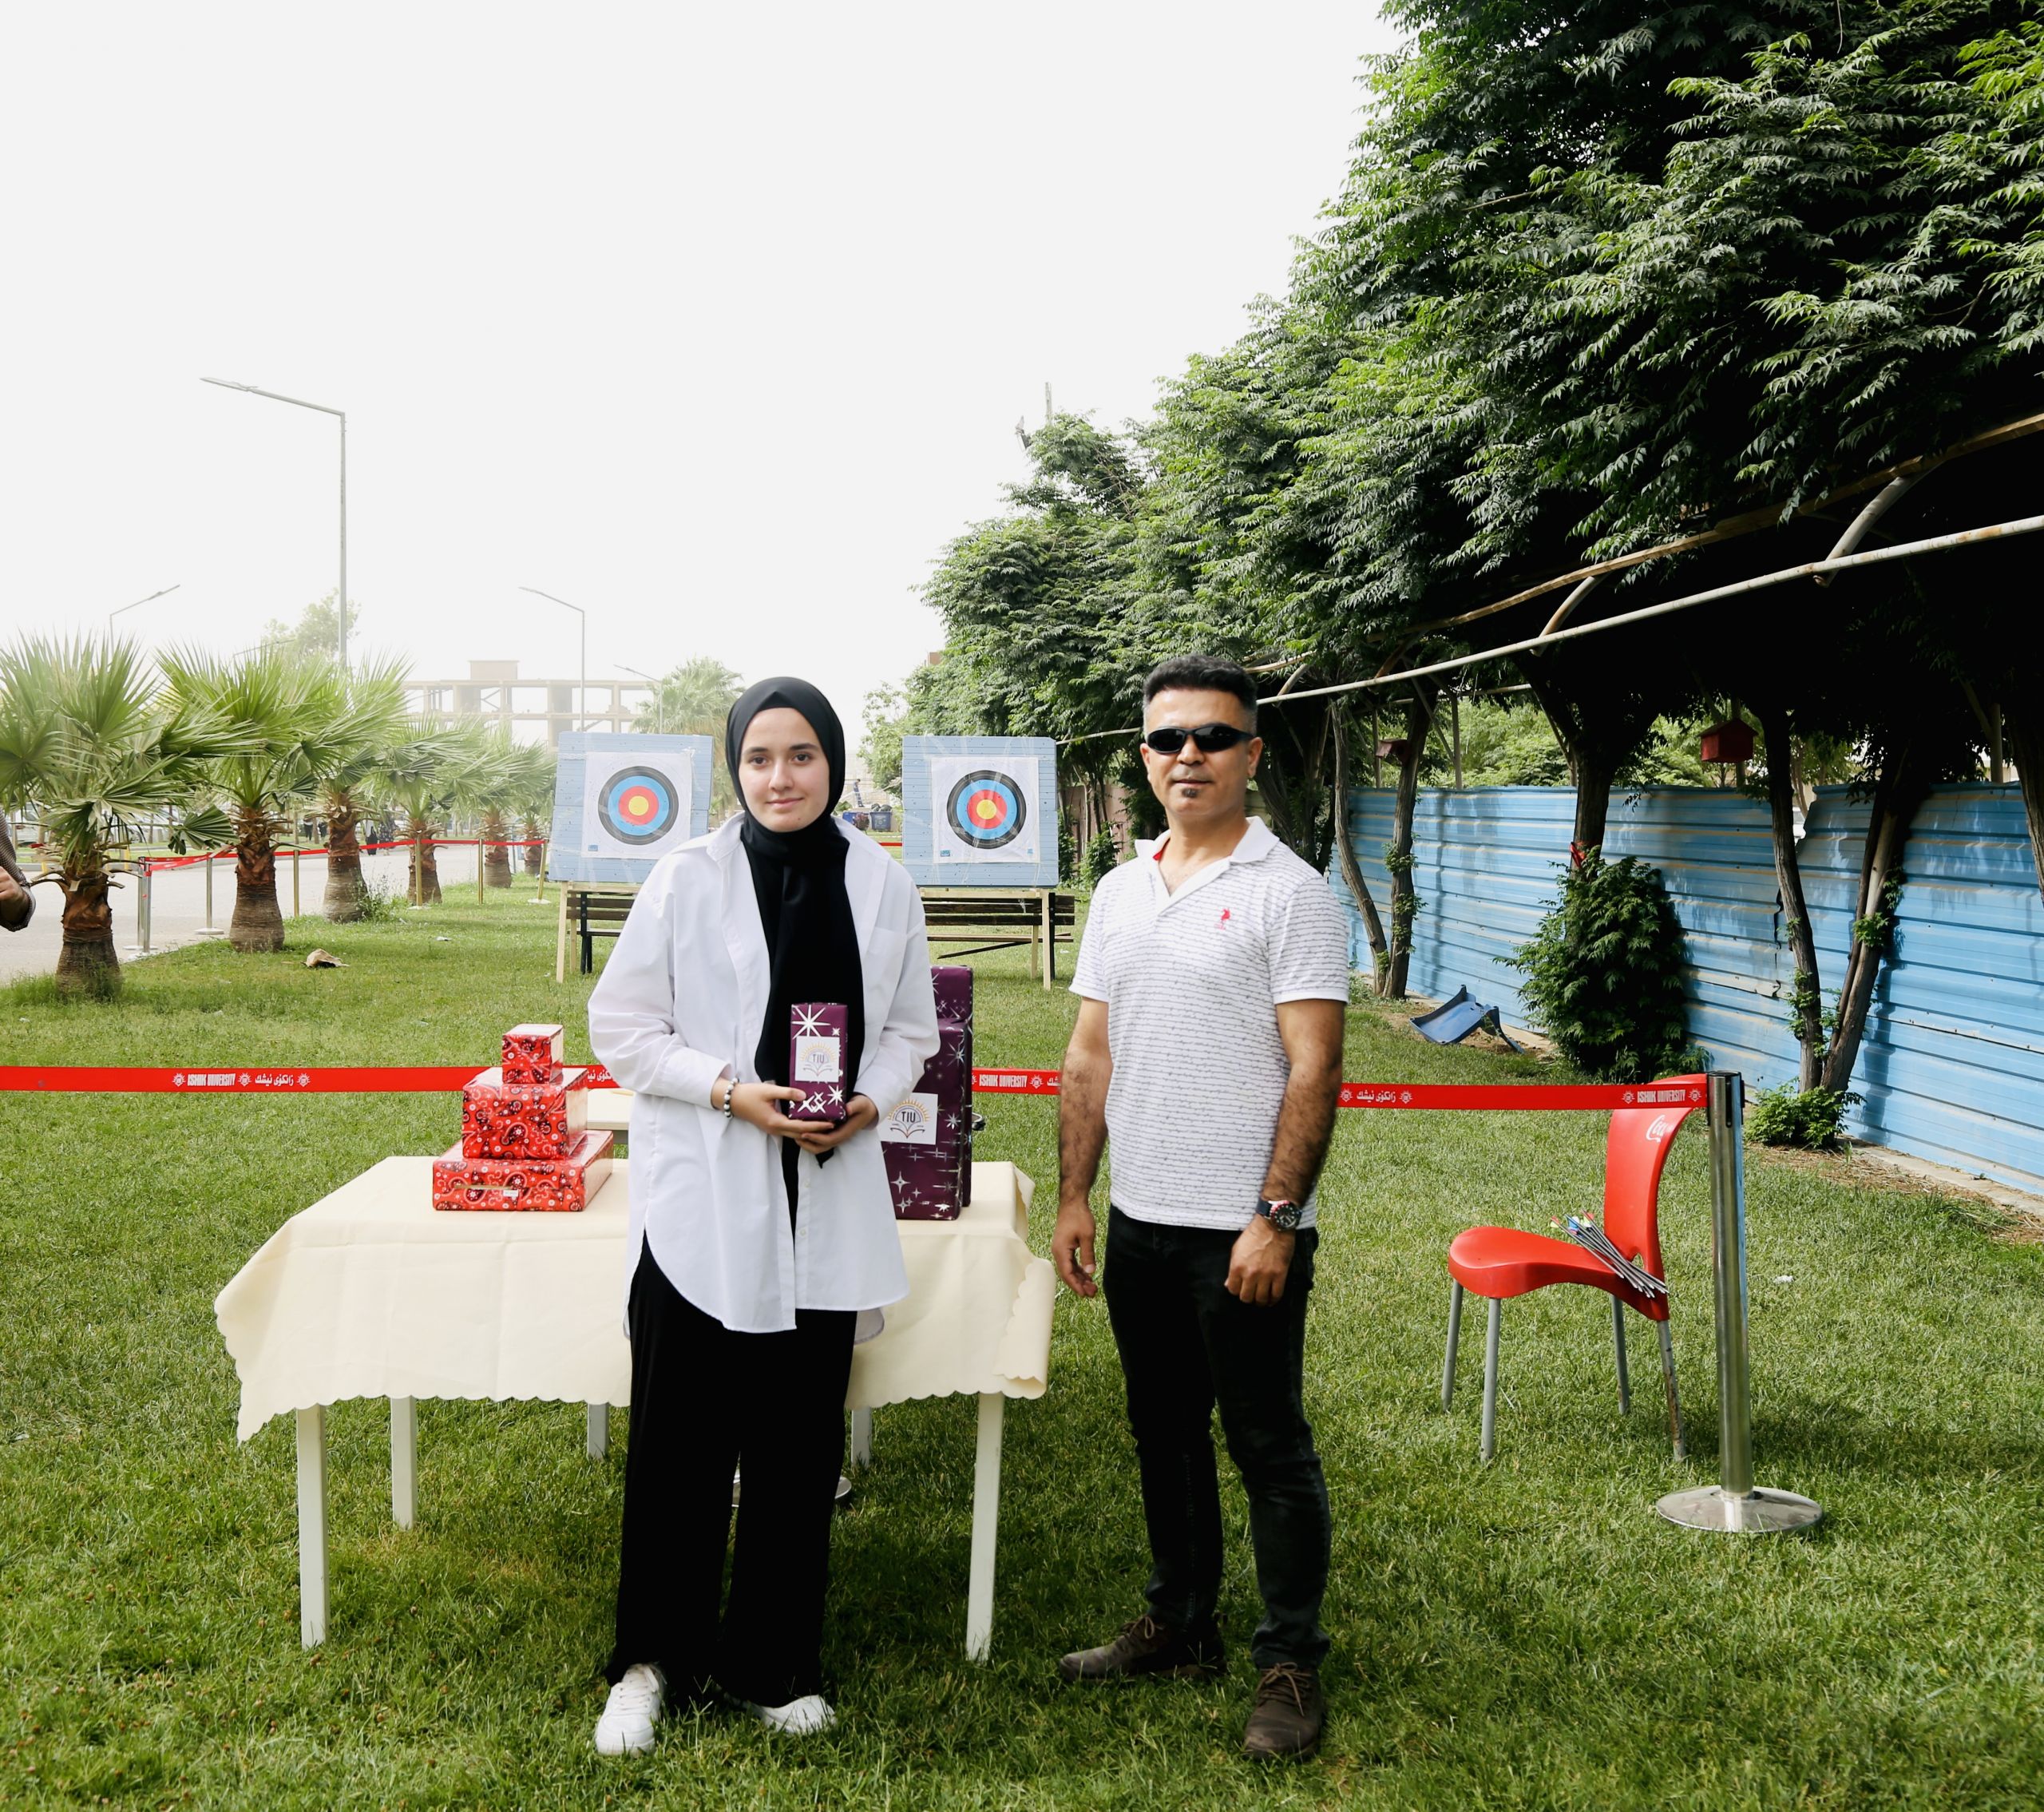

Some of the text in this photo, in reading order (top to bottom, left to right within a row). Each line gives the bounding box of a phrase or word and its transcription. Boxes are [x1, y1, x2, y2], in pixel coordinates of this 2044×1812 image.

[812, 1053, 825, 1064] TIU
[188, 1073, 236, 1086] ISHIK UNIVERSITY
[979, 1074, 1028, 1088] ISHIK UNIVERSITY
[1637, 1089, 1686, 1103] ISHIK UNIVERSITY
[901, 1111, 916, 1123] TIU
